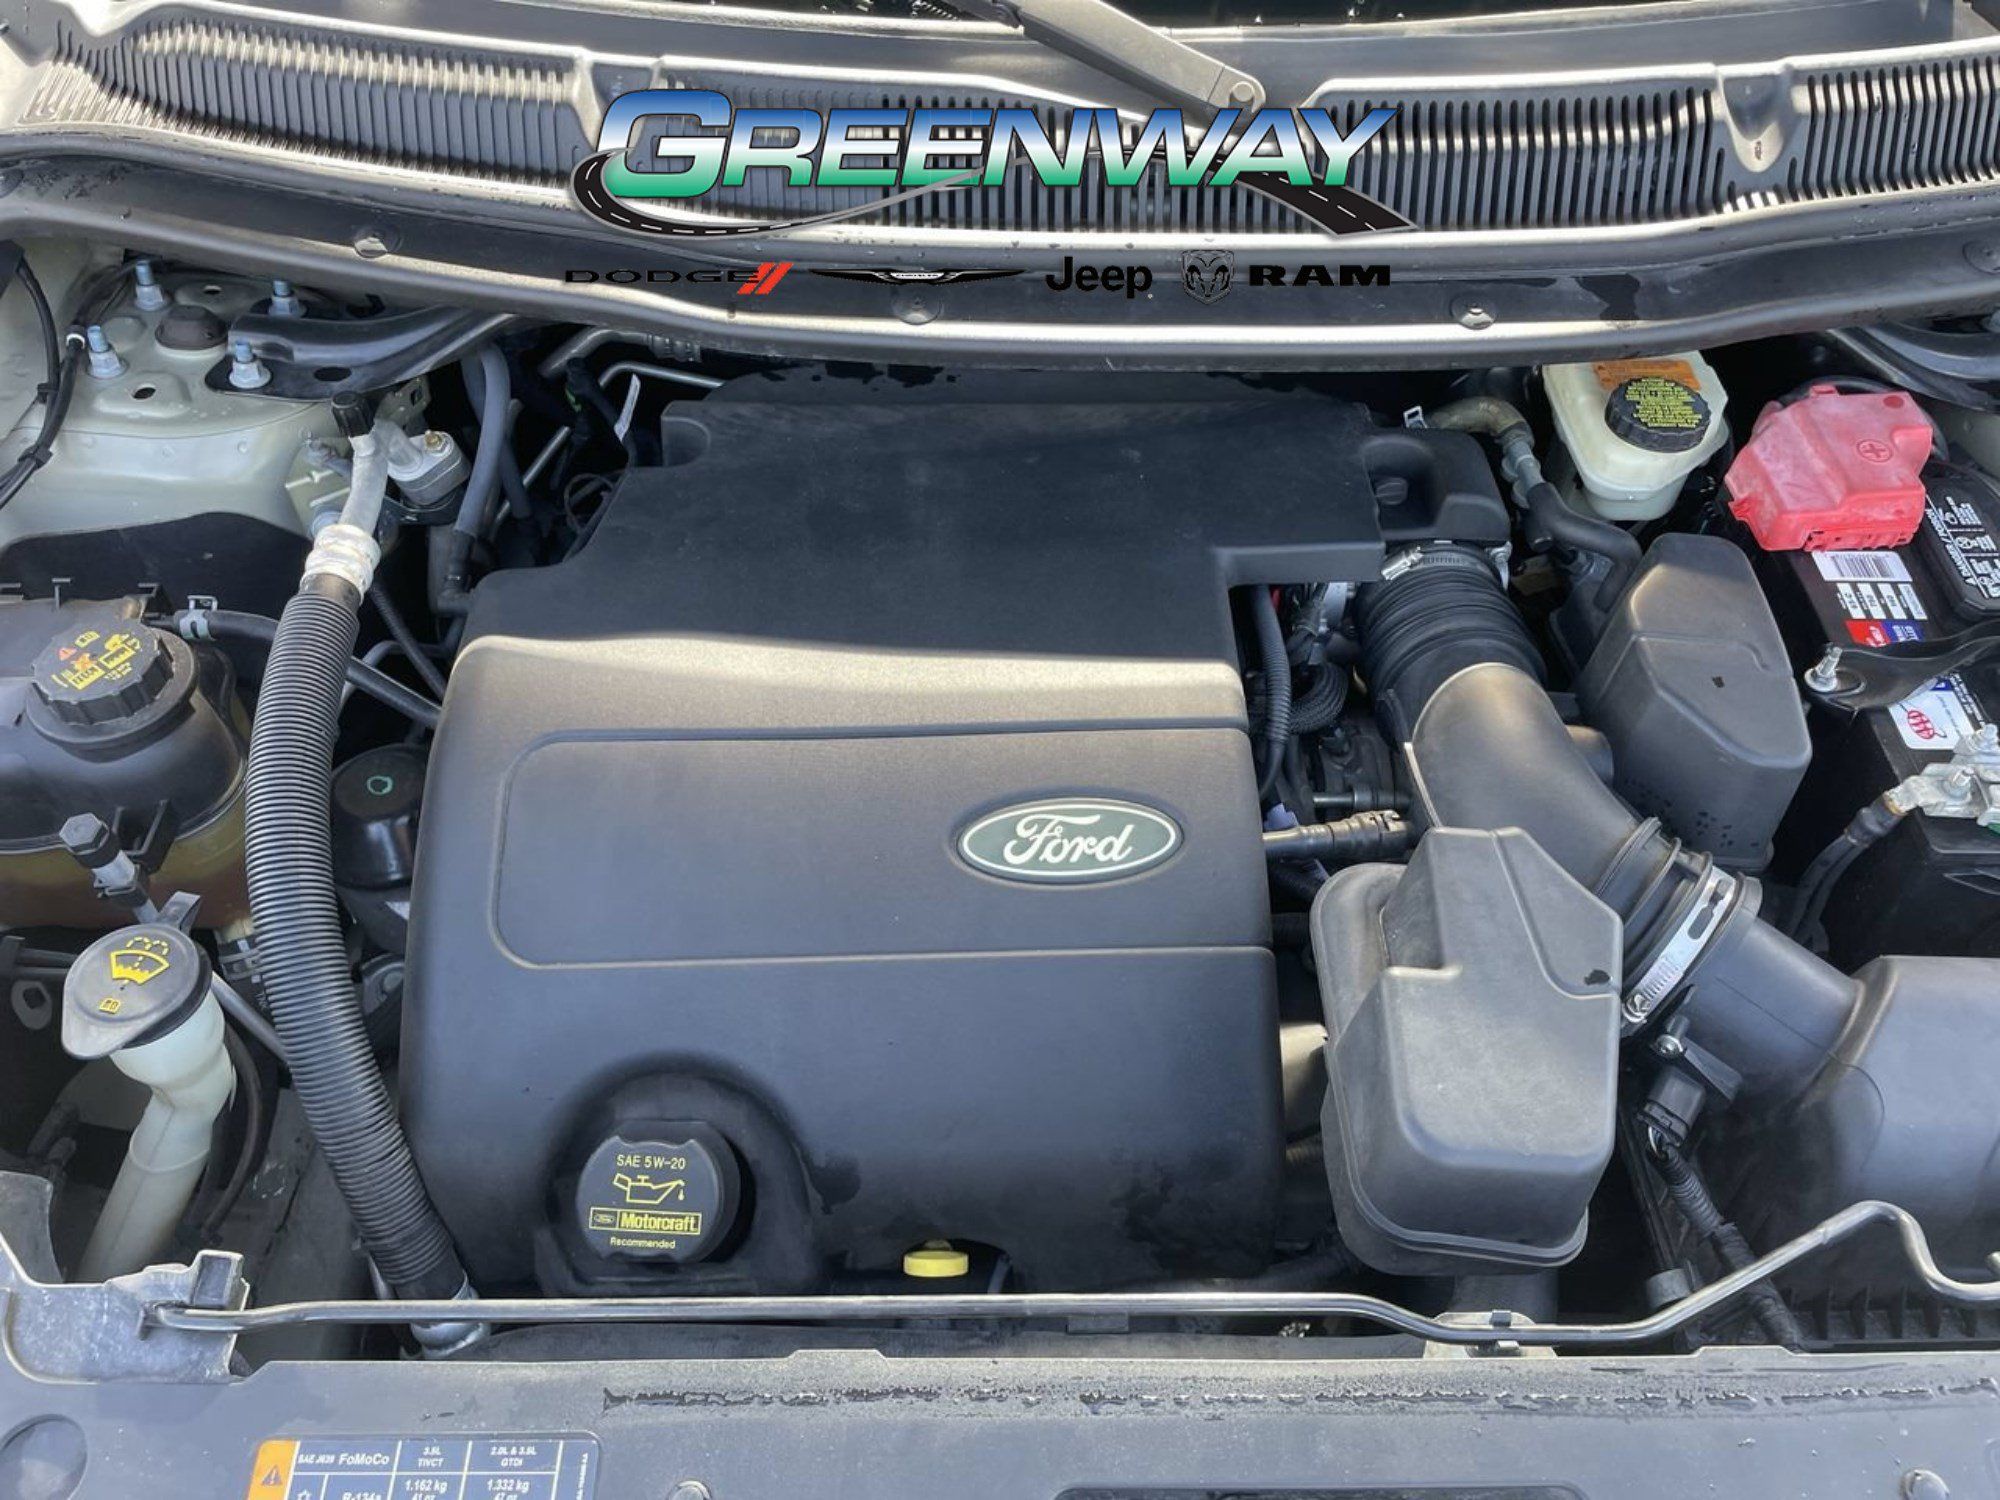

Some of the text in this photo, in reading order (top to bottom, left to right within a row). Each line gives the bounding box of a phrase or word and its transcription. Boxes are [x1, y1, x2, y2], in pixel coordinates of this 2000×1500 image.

[1002, 813, 1136, 865] Ford
[616, 1154, 687, 1170] SAE 5W-20
[620, 1212, 699, 1232] Motorcraft
[610, 1236, 676, 1249] Recommended
[338, 1452, 390, 1465] FoMoCo
[404, 1478, 448, 1493] 1.162 kg
[515, 1478, 530, 1493] kg
